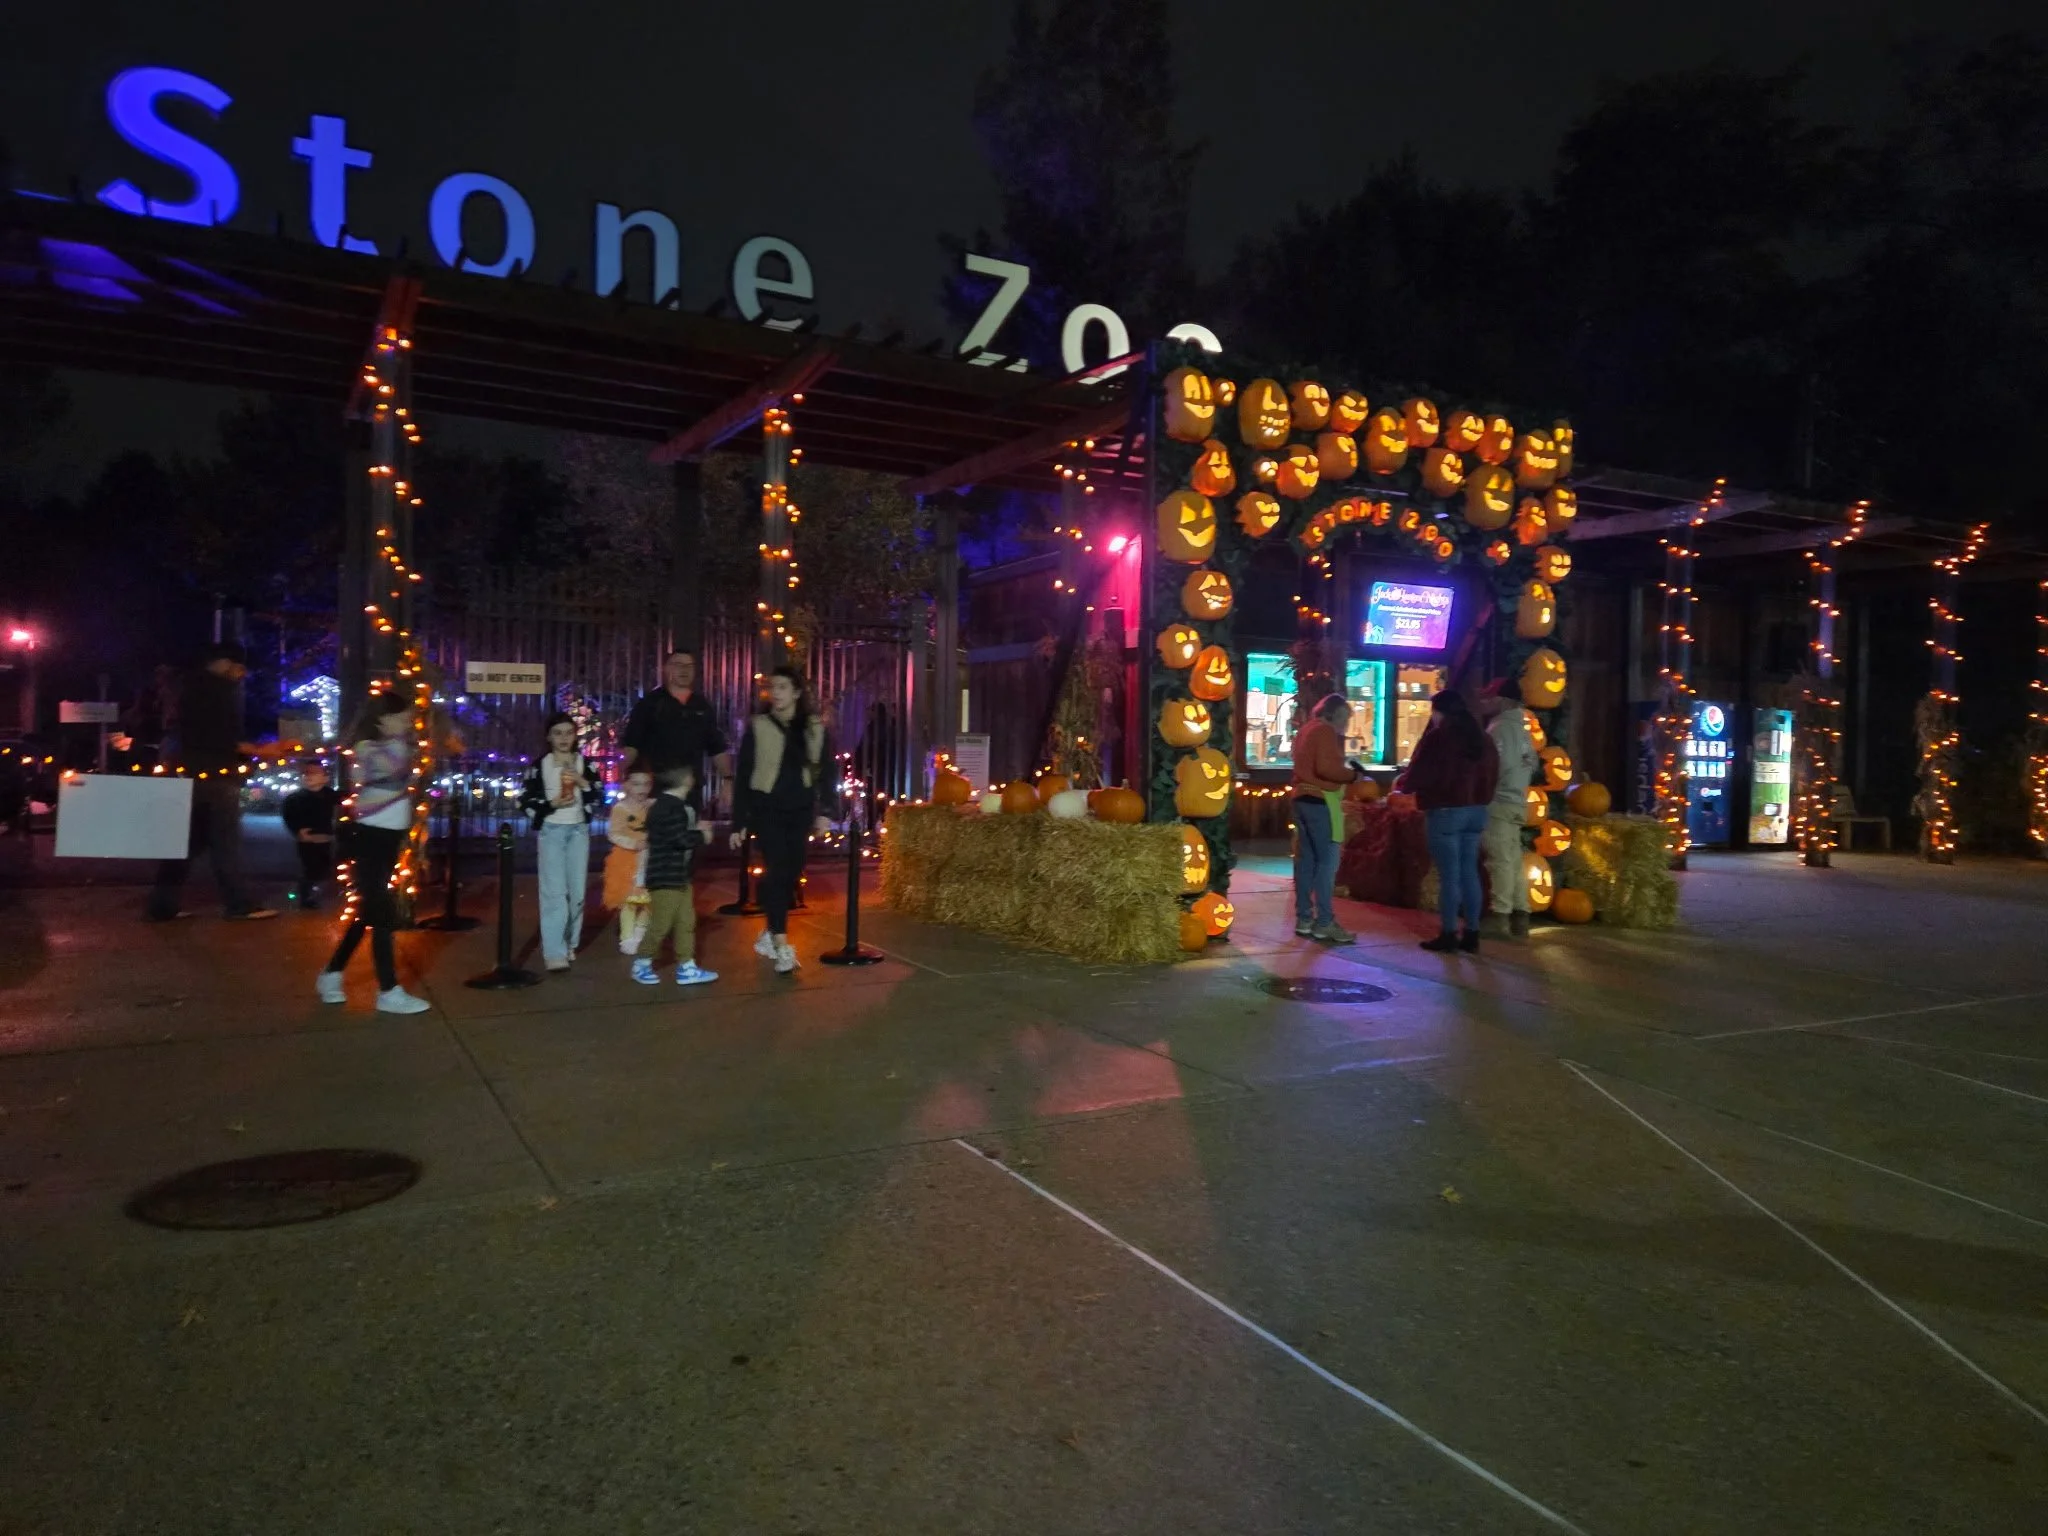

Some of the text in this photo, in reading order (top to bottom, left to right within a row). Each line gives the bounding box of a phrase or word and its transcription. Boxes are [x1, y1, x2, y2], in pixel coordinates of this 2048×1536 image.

[96, 67, 815, 331] Stone
[1312, 501, 1453, 557] STONE ZOO
[470, 673, 542, 684] DO NOT ENTER
